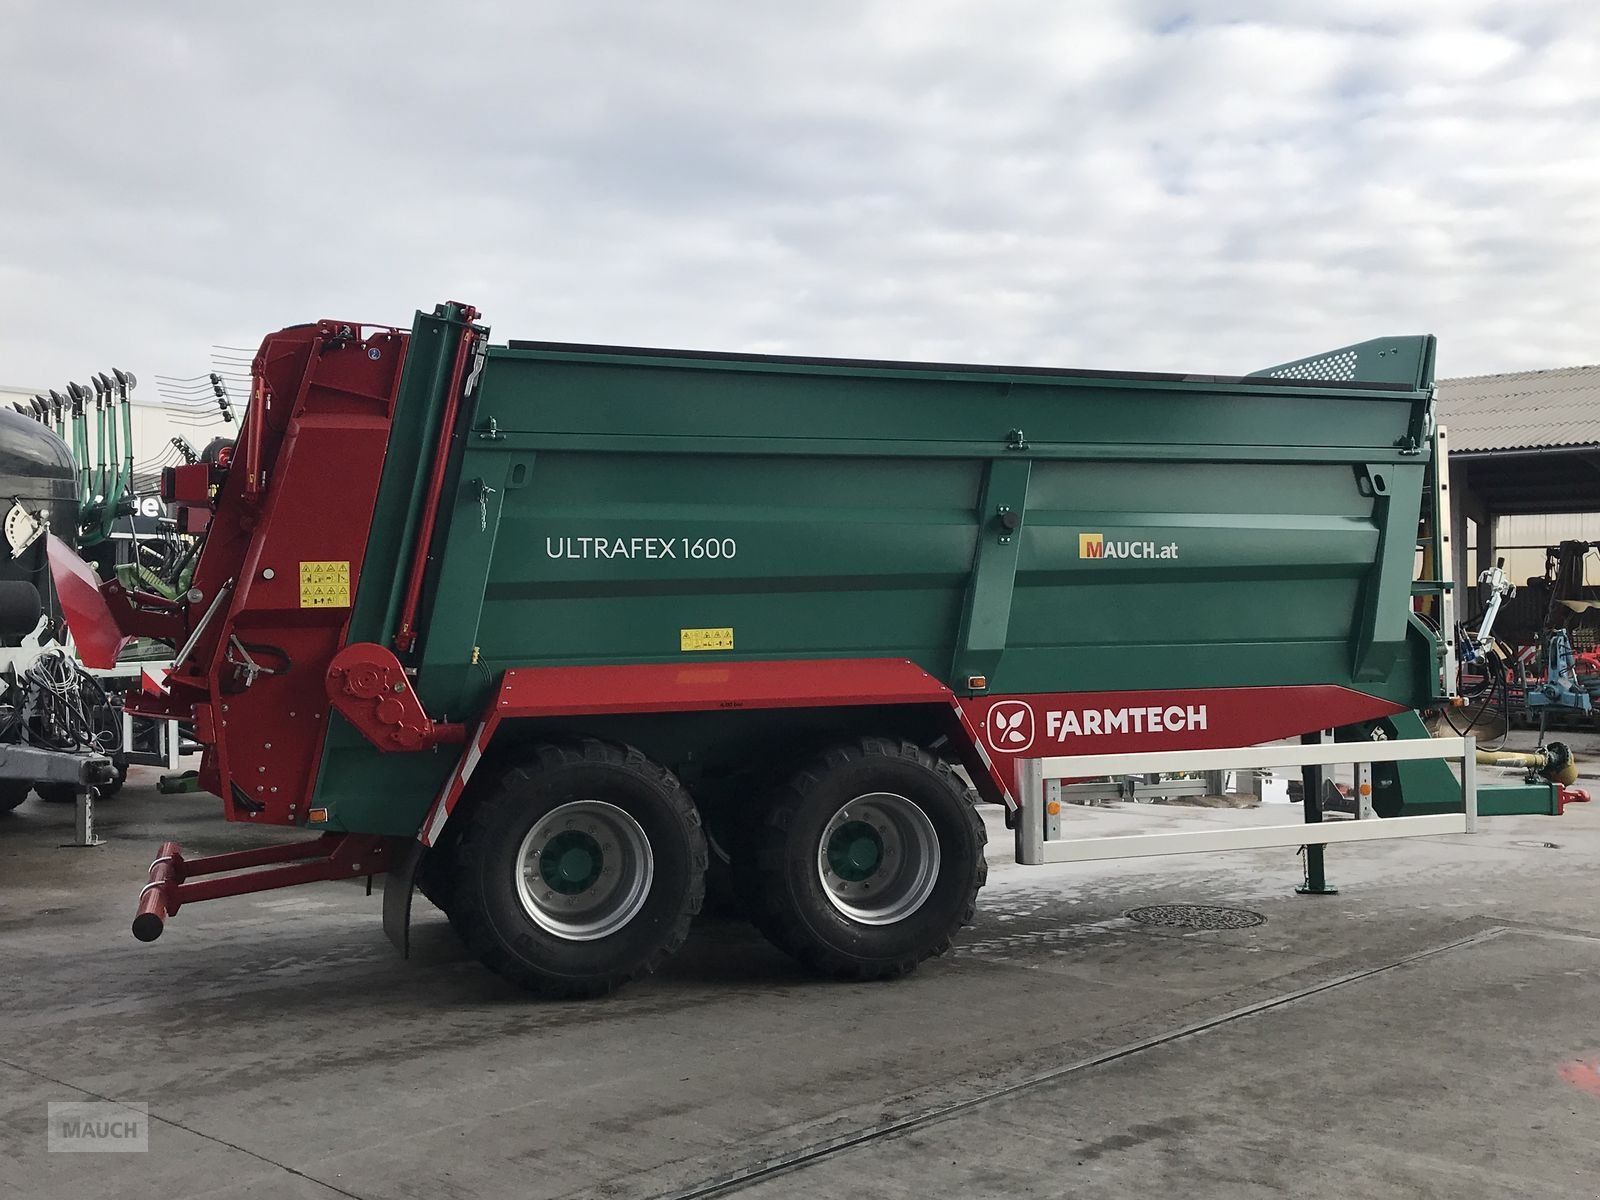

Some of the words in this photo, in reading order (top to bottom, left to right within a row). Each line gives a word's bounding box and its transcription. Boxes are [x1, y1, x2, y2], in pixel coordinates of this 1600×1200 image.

[546, 537, 676, 559] ULTRAFEX
[682, 538, 736, 559] 1600
[1086, 541, 1179, 559] MAUCH.at
[1046, 704, 1208, 742] FARMTECH
